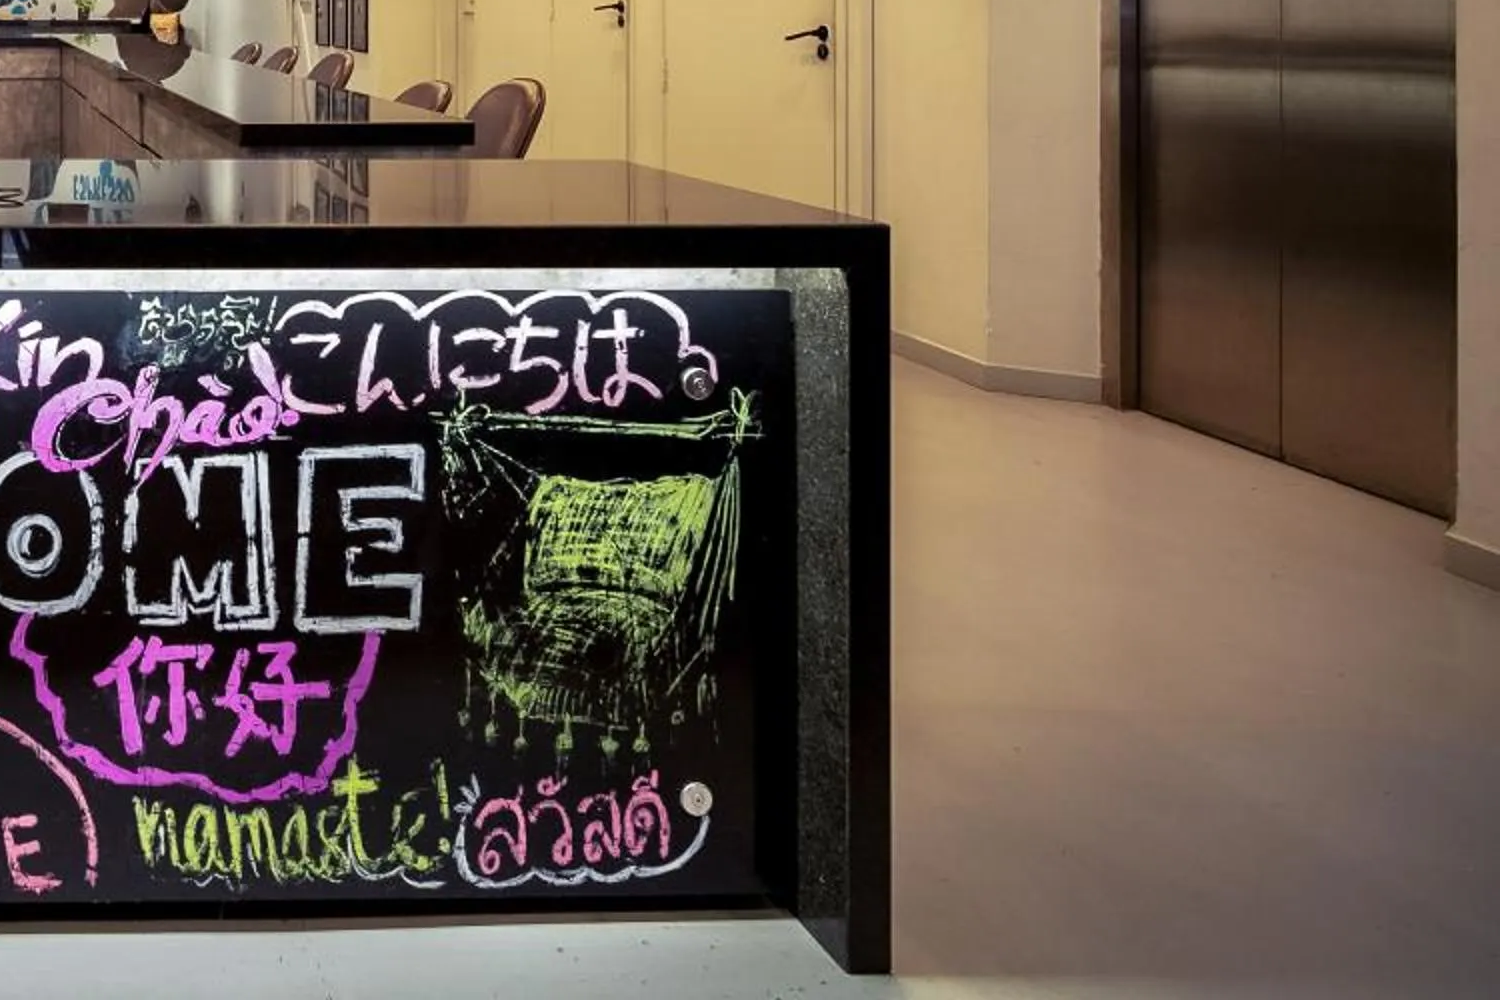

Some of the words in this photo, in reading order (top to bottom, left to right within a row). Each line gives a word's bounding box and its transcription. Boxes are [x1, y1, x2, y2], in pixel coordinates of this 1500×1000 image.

[281, 307, 664, 416] こんにちは
[93, 634, 331, 757] 你好
[473, 768, 671, 875] สวัสดี
